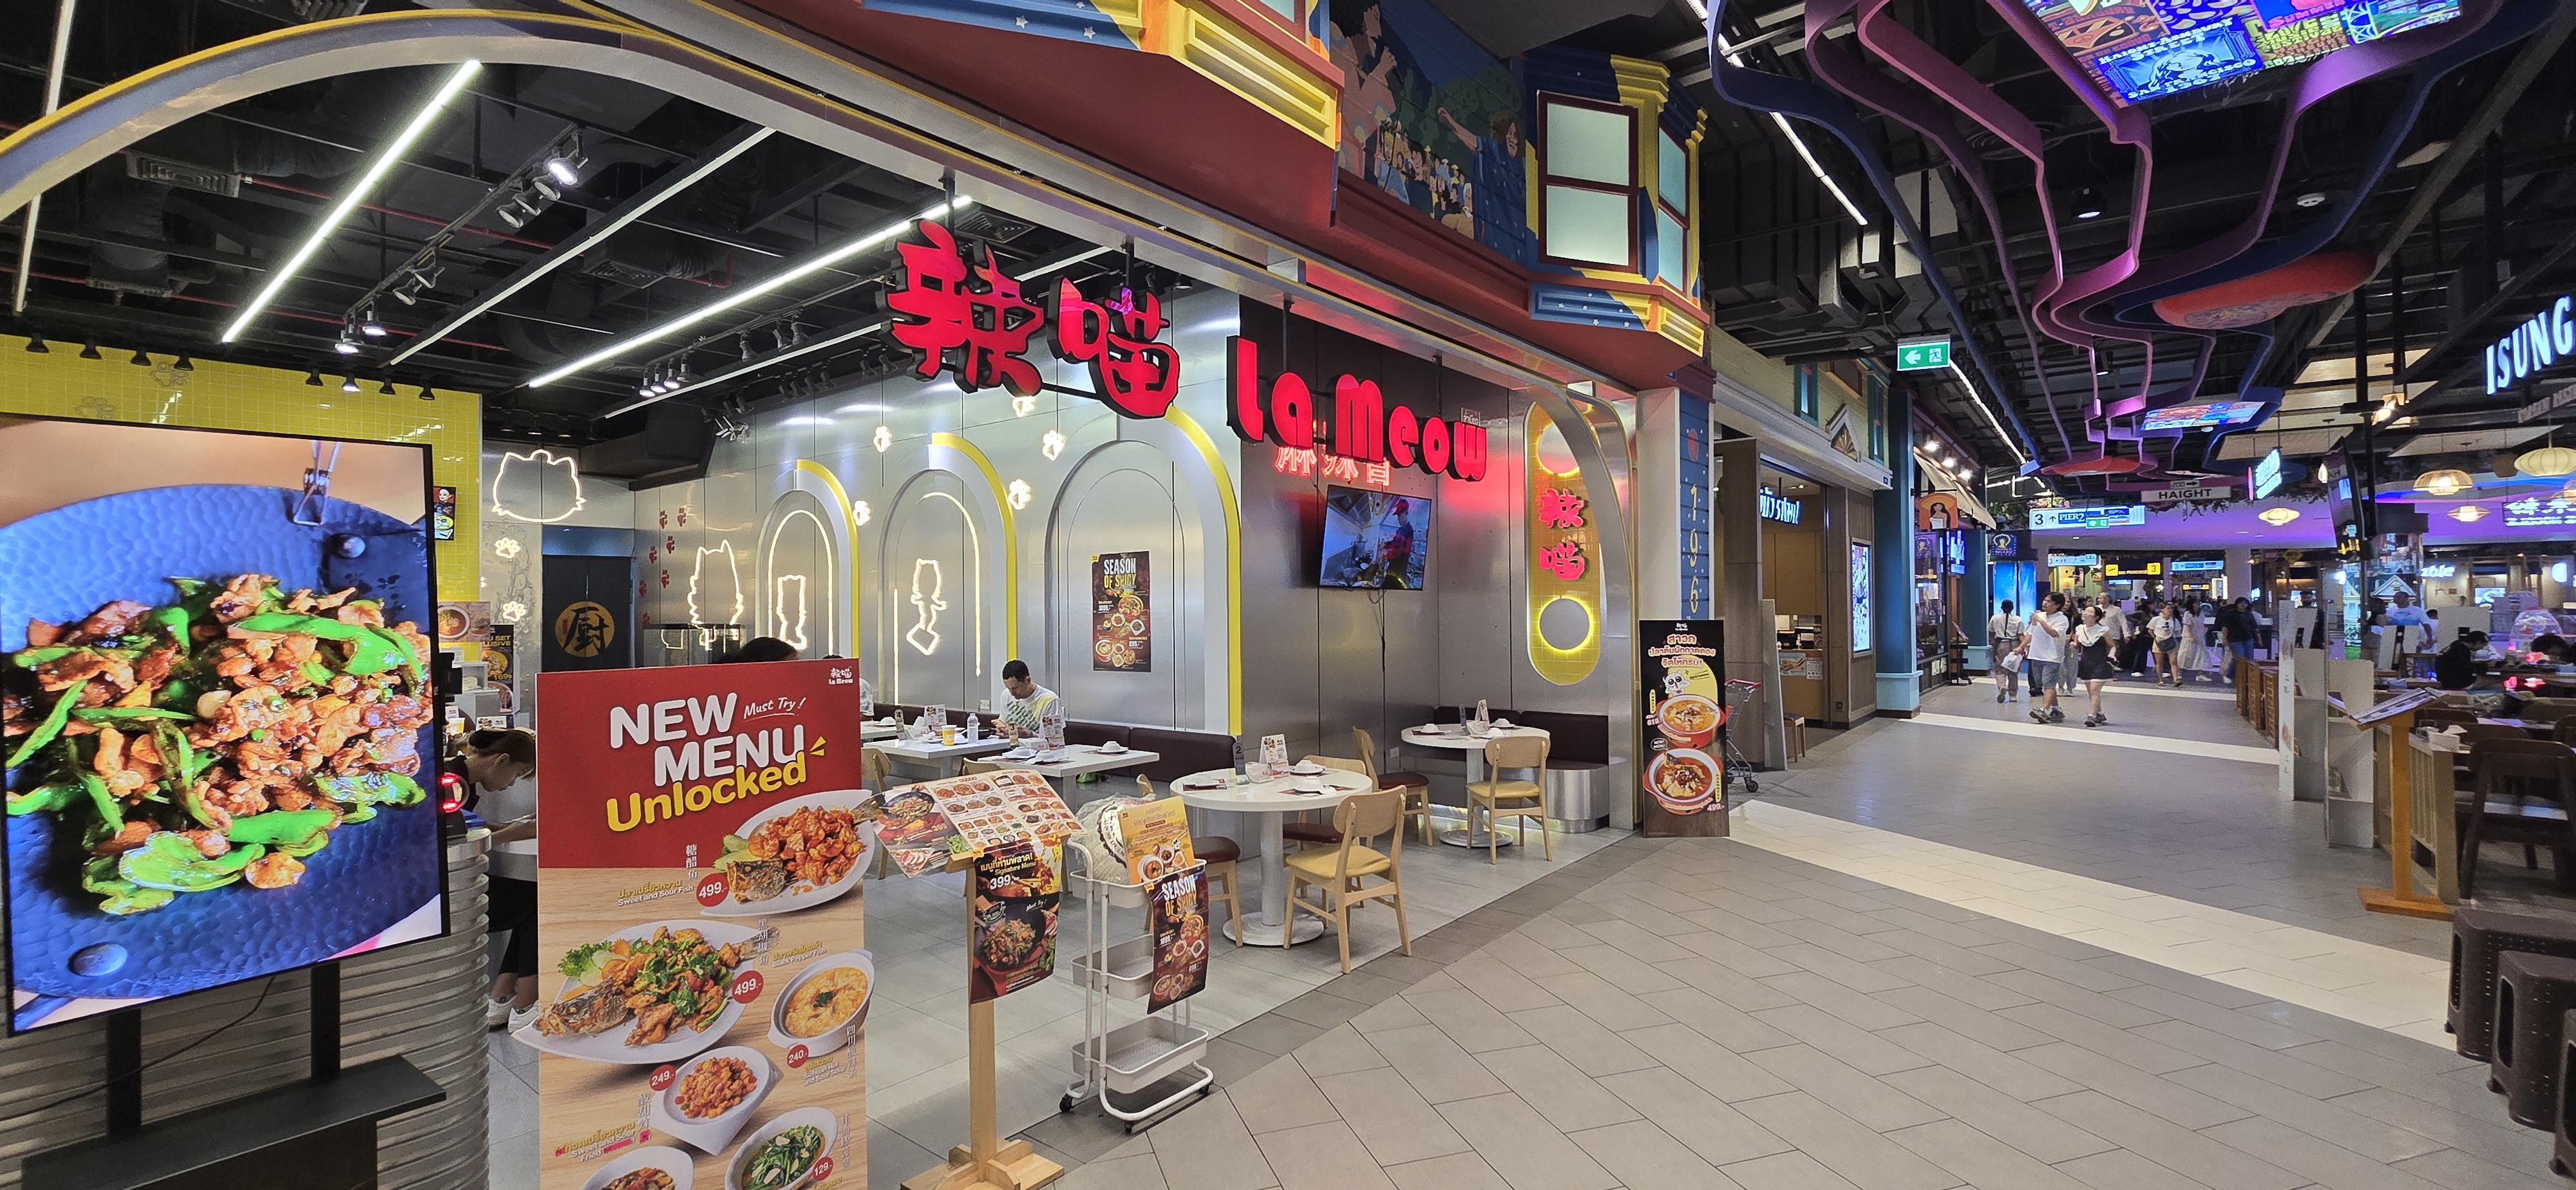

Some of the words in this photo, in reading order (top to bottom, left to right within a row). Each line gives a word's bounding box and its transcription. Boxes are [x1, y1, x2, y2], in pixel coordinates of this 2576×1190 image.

[2131, 32, 2206, 61] STREET
[2127, 80, 2161, 99] SAN
[885, 219, 1180, 419] 辣喵
[2486, 296, 2573, 395] ISUNG
[1227, 335, 1314, 449] La
[1328, 373, 1488, 482] Meow
[2158, 489, 2212, 500] HAIGHT
[2034, 513, 2044, 525] 3
[1104, 558, 1137, 575] SEASON
[1104, 574, 1113, 589] OF
[1115, 573, 1137, 588] SPICY
[1667, 634, 1698, 645] สาวก
[743, 699, 774, 720] Must
[610, 692, 738, 749] NEW
[654, 725, 806, 788] MENU
[1235, 745, 1242, 754] 2
[607, 751, 807, 832] Unlocked
[994, 865, 1021, 876] Signature
[1021, 861, 1036, 870] Menu
[618, 896, 643, 907] Sweet
[643, 892, 658, 901] and
[659, 888, 677, 897] Sour
[678, 884, 694, 894] Fish
[1162, 874, 1197, 902] SEASON
[1165, 900, 1175, 917] OF
[1176, 891, 1197, 912] SPICY
[773, 957, 791, 968] Black
[791, 952, 813, 963] Pepper
[813, 948, 827, 957] Fish
[804, 1077, 816, 1087] and
[815, 1073, 831, 1082] Sour
[830, 1066, 846, 1076] Soup
[571, 1145, 600, 1158] Sweet
[600, 1137, 615, 1149] and
[616, 1129, 636, 1140] Sour
[580, 1148, 602, 1163] Fried
